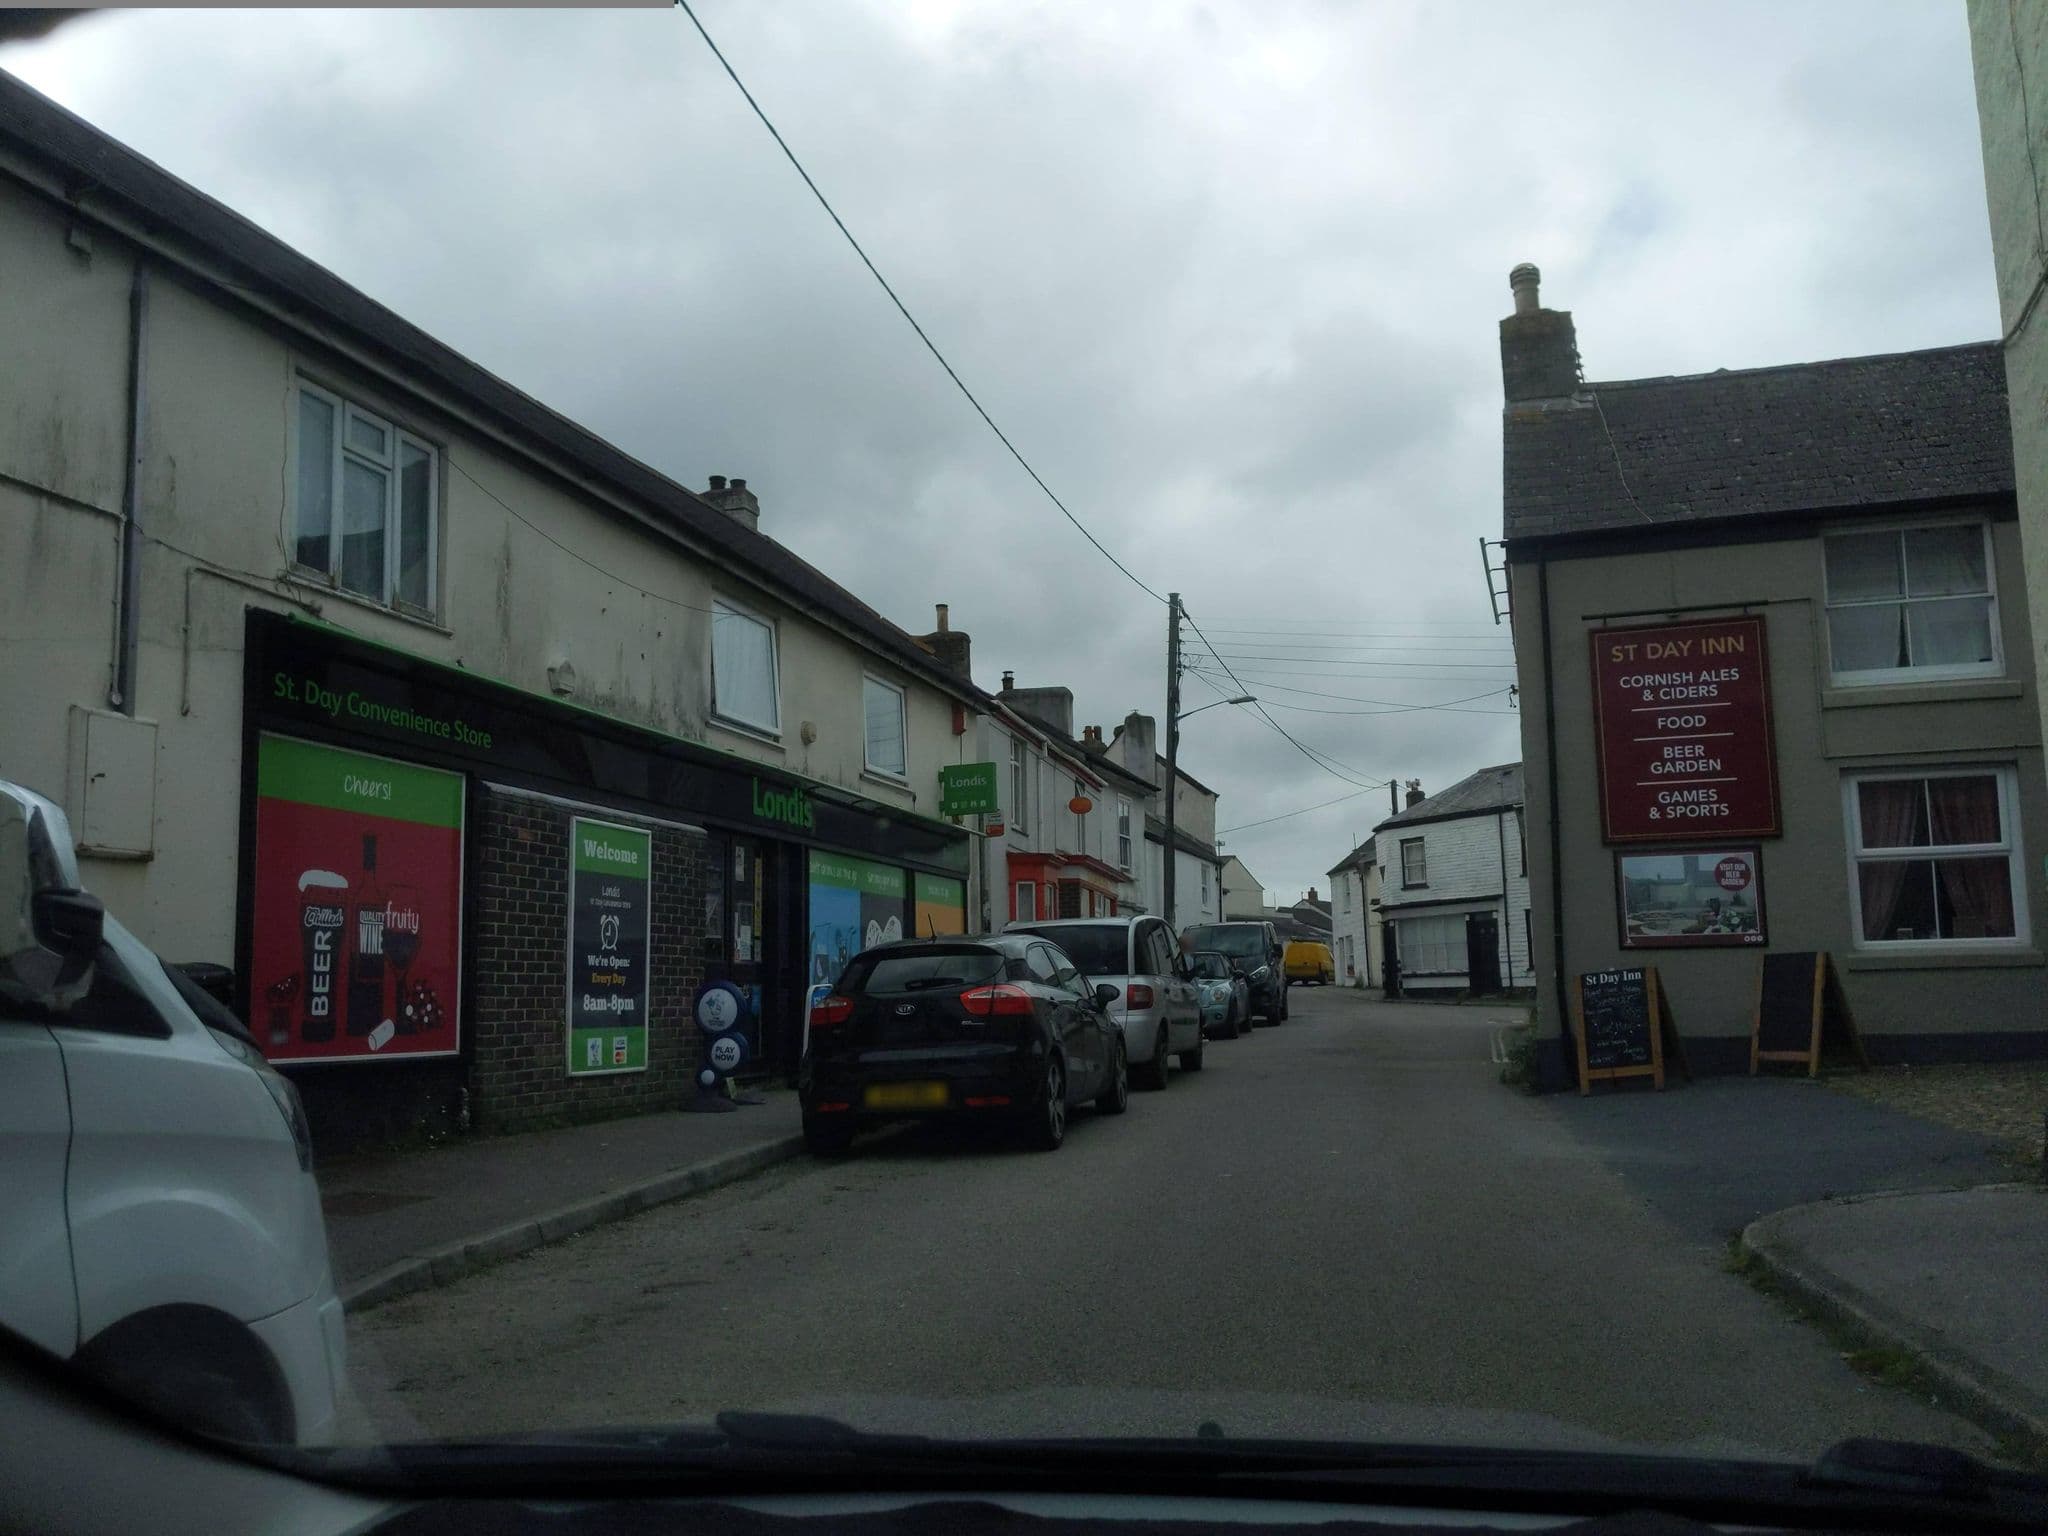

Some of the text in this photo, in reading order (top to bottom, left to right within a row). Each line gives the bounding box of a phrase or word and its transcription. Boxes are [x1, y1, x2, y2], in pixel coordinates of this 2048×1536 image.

[1611, 635, 1745, 662] ST DAY INN
[1619, 668, 1740, 688] CORNISH ALES
[1642, 684, 1719, 702] & CIDERS
[273, 671, 494, 750] St. Day Convenience Store
[1657, 714, 1707, 729] FOOD
[1663, 744, 1706, 759] BEER
[1650, 758, 1722, 774] GARDEN
[950, 776, 987, 788] Londis
[752, 775, 815, 833] Londis
[1658, 788, 1719, 804] GAMES
[1649, 803, 1730, 820] & SPORTS
[583, 839, 639, 865] Welcome
[1720, 863, 1733, 871] VISIT
[303, 906, 345, 928] Chilled
[360, 910, 385, 923] QUALITY
[385, 900, 420, 935] fruity
[359, 923, 384, 955] WINE
[587, 954, 631, 970] We're Open:
[311, 929, 333, 1016] BEER
[591, 972, 627, 987] Every Day
[1585, 970, 1642, 986] St Day Inn
[583, 993, 635, 1016] 8am-8pm
[715, 1054, 736, 1062] NOW
[716, 1046, 735, 1054] PLAY
